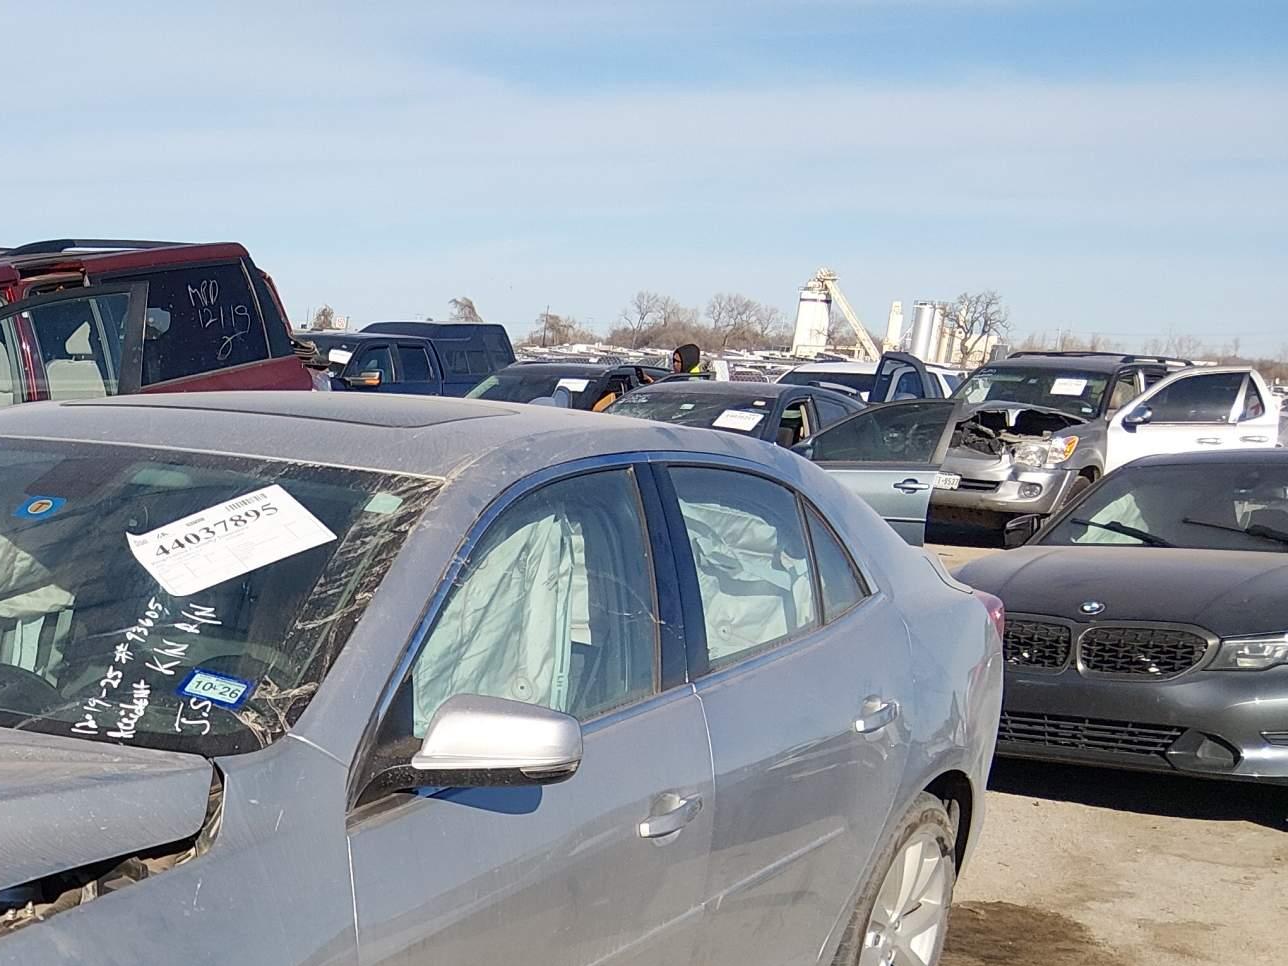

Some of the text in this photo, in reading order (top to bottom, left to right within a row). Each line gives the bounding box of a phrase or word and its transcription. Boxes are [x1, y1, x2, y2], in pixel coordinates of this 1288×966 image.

[155, 502, 279, 557] 44037895
[194, 680, 240, 699] 10 26
